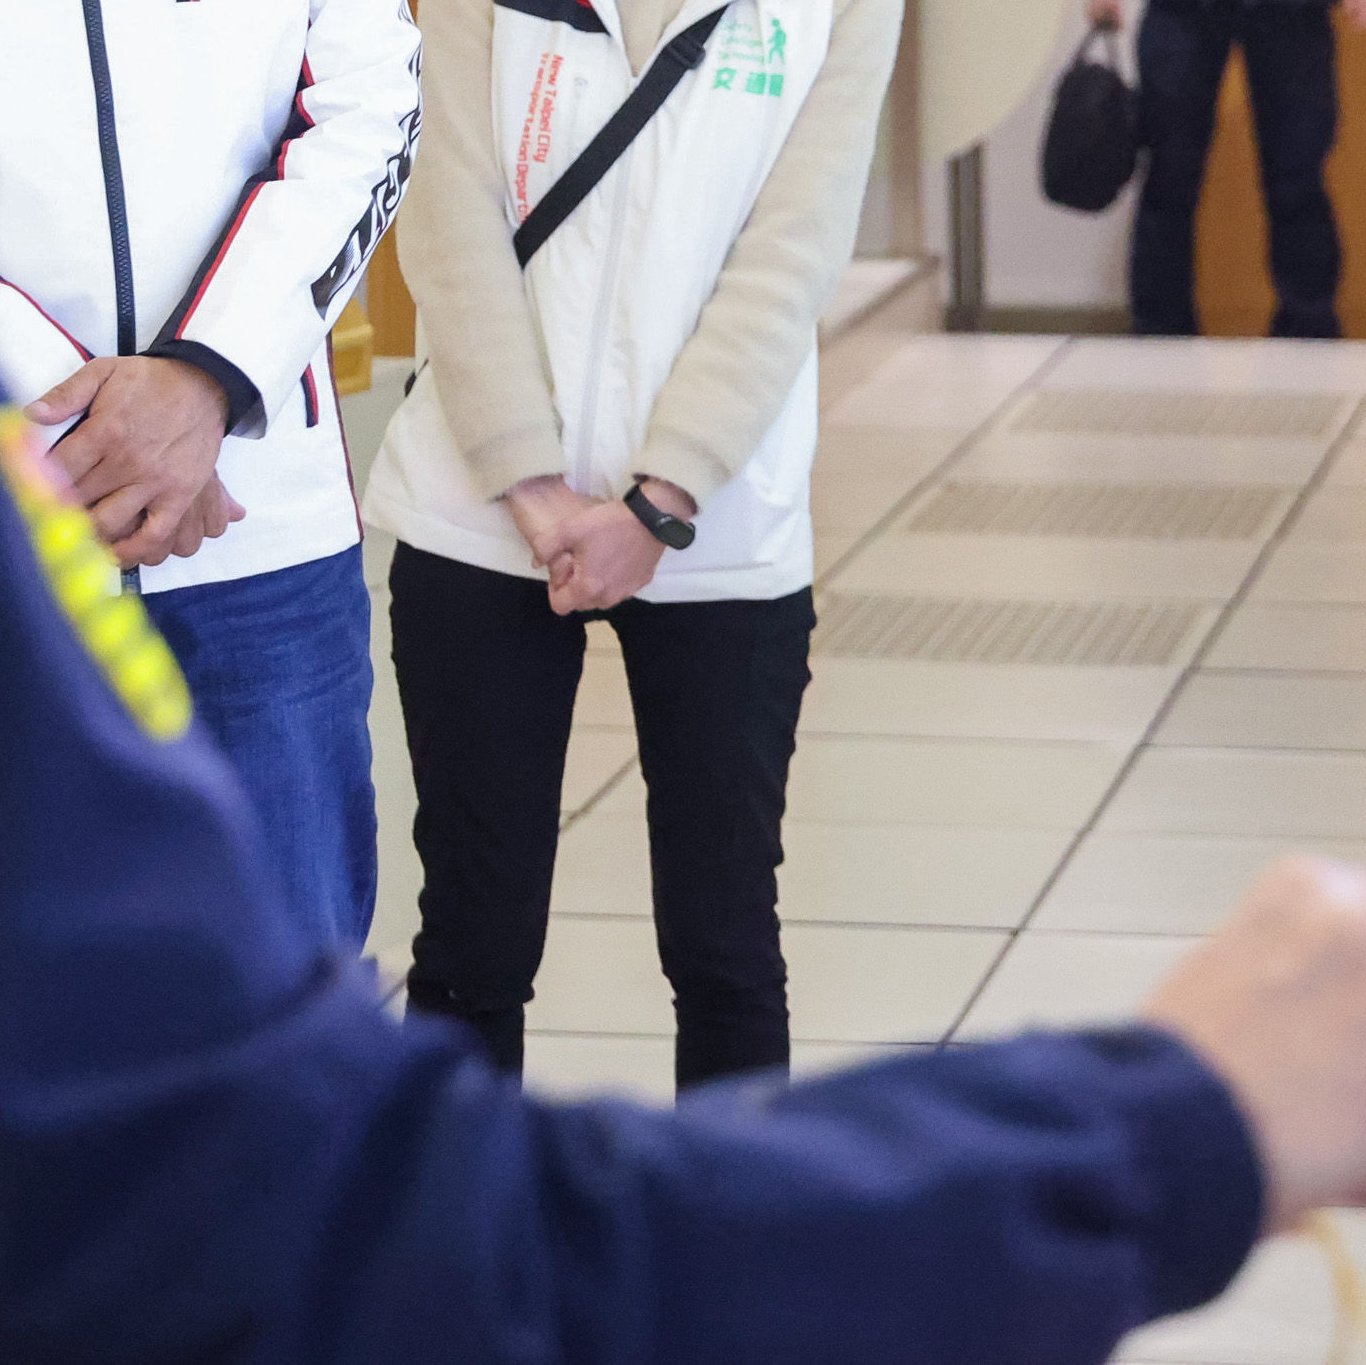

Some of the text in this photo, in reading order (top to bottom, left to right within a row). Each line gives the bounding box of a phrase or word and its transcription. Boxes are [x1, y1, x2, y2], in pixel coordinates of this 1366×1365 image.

[533, 54, 564, 164] New Taipei City
